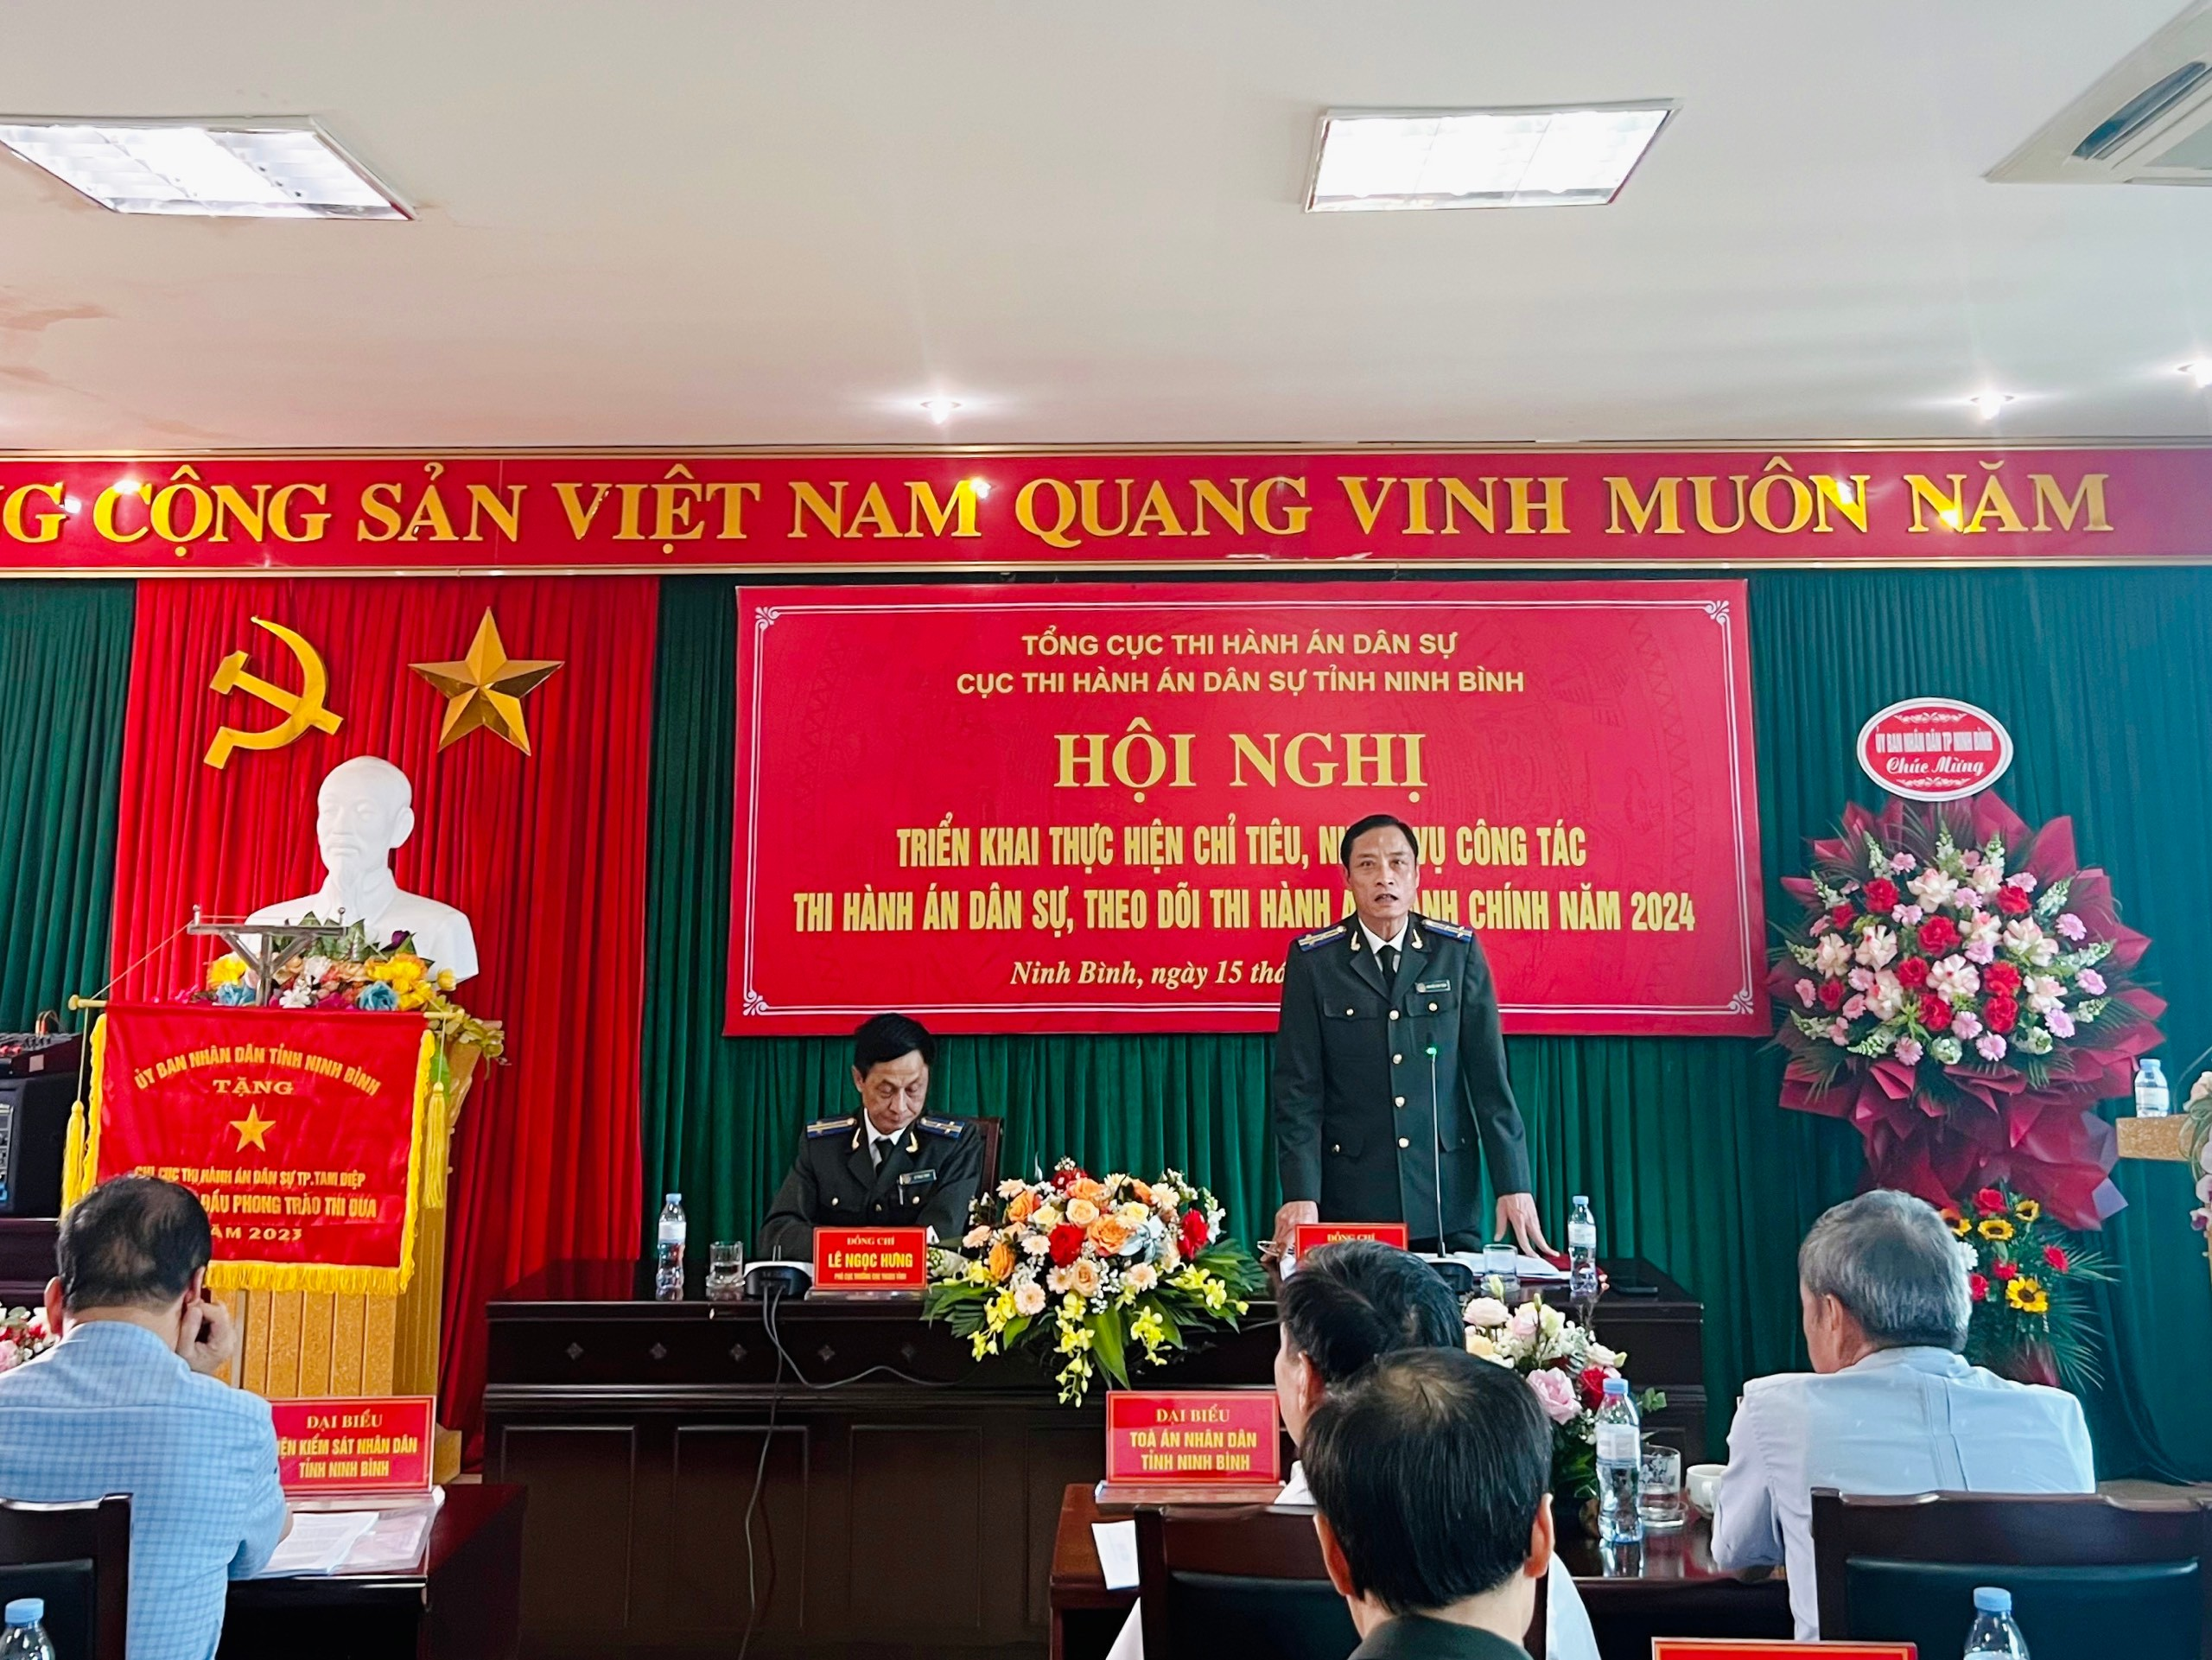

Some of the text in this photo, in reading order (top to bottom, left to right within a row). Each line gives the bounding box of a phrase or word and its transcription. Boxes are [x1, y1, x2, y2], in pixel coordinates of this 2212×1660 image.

[92, 464, 331, 557] CỘNG
[357, 461, 527, 544] SẢN
[551, 464, 760, 554] VIỆT
[787, 480, 982, 540] NAM
[1014, 477, 1312, 549] QUANG
[1338, 476, 1572, 536] VINH
[1603, 456, 1870, 535] MUÔN
[1904, 460, 2114, 535] NĂM
[1021, 625, 1458, 660] TỔNG CỤC THI HÀNH ÁN DÂN SỰ
[957, 663, 1524, 699] CỤC THI HÀNH ÁN DÂN SỰ TỈNH NINH BÌNH
[1054, 716, 1428, 803] HỘI NGHỊ
[1886, 756, 1985, 776] Chúc Mừng
[897, 812, 969, 867] TRIỂN
[980, 826, 1039, 867] KHAI
[1049, 822, 1114, 874] THỰC
[1124, 818, 1184, 874] HIỆN
[1194, 813, 1237, 866] CHỈ
[1245, 817, 1310, 869] TIÊU,
[1412, 826, 1446, 874] VỤ
[1457, 818, 1527, 867] CÔNG
[1536, 822, 1588, 868] TÁC
[793, 892, 833, 932] THI
[843, 884, 913, 931] HÀNH
[922, 882, 959, 931] ÁN
[969, 881, 1022, 930] DÂN
[1033, 886, 1074, 937] SỰ,
[1084, 889, 1147, 929] THEO
[1157, 881, 1200, 929] DÕI
[1210, 888, 1249, 929] THI
[1261, 881, 1331, 929] HÀNH
[1470, 882, 1549, 930] CHÍNH
[1560, 882, 1621, 931] NĂM
[1630, 891, 1695, 932] 2024
[1009, 960, 1071, 985] Ninh
[1077, 960, 1144, 989] Bình,
[1151, 961, 1209, 989] ngày
[1214, 960, 1244, 983] 15
[156, 1054, 188, 1078] BAN
[188, 1045, 231, 1068] NHÂN
[234, 1043, 266, 1064] DÂN
[269, 1042, 303, 1068] TỈNH
[304, 1054, 344, 1078] NINH
[343, 1065, 382, 1097] BÌNH
[213, 1076, 294, 1097] TẶNG
[200, 1166, 233, 1184] HÀNH
[234, 1167, 251, 1184] ÁN
[253, 1167, 277, 1185] DÂN
[232, 1195, 282, 1215] PHONG
[283, 1192, 321, 1216] TRÀO
[324, 1197, 346, 1217] THI
[348, 1198, 377, 1218] ĐUA
[210, 1224, 302, 1241] ĂM 2023
[828, 1250, 842, 1268] LÊ
[845, 1252, 877, 1270] NGỌC
[341, 1409, 383, 1428] BIỂU
[1191, 1403, 1230, 1423] BIỂU
[299, 1433, 329, 1455] KIỂM
[332, 1435, 354, 1455] SÁT
[357, 1434, 390, 1455] NHÂN
[392, 1434, 417, 1453] DÂN
[1160, 1428, 1180, 1448] ÁN
[1184, 1428, 1224, 1447] NHÂN
[1228, 1428, 1257, 1447] DÂN
[298, 1457, 390, 1479] TỈNH NINH BÌNH
[1141, 1449, 1250, 1471] TỈNH NINH BÌNH
